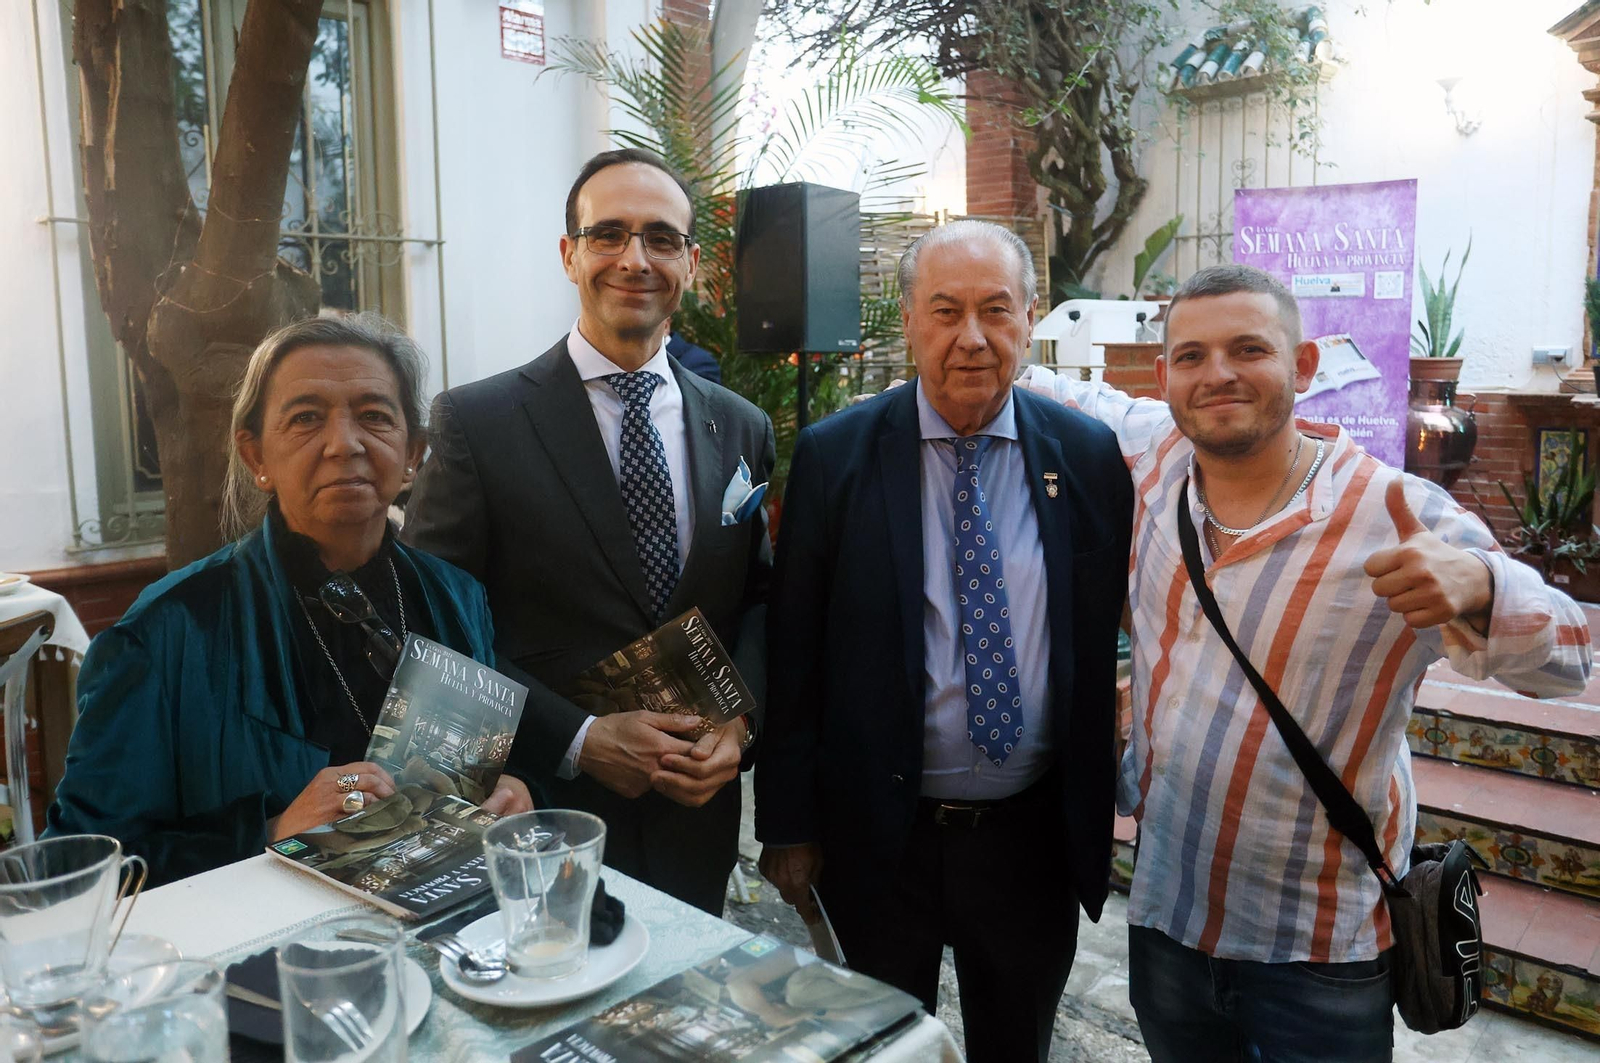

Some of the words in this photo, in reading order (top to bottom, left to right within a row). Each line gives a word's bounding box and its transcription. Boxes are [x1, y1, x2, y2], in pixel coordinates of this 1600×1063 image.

[1240, 225, 1322, 255] SEMANA
[1334, 221, 1405, 251] SANTA
[1287, 252, 1330, 269] HUELVA
[1346, 253, 1405, 268] PROVINCIA
[1294, 276, 1332, 286] Huelva
[1341, 414, 1356, 426] de
[1357, 414, 1400, 427] Huelva,
[410, 638, 467, 682] SEMANA
[473, 668, 516, 707] SANTA
[681, 615, 717, 667] SEMANA
[712, 665, 742, 709] SANTA
[440, 672, 468, 695] HUELVA
[478, 693, 513, 718] PROVINCIA
[687, 650, 706, 676] HUELVA
[707, 681, 730, 715] PROVINCIA
[398, 874, 451, 899] PROVINCIA
[409, 873, 482, 904] SANTA
[1453, 869, 1480, 1025] FILA
